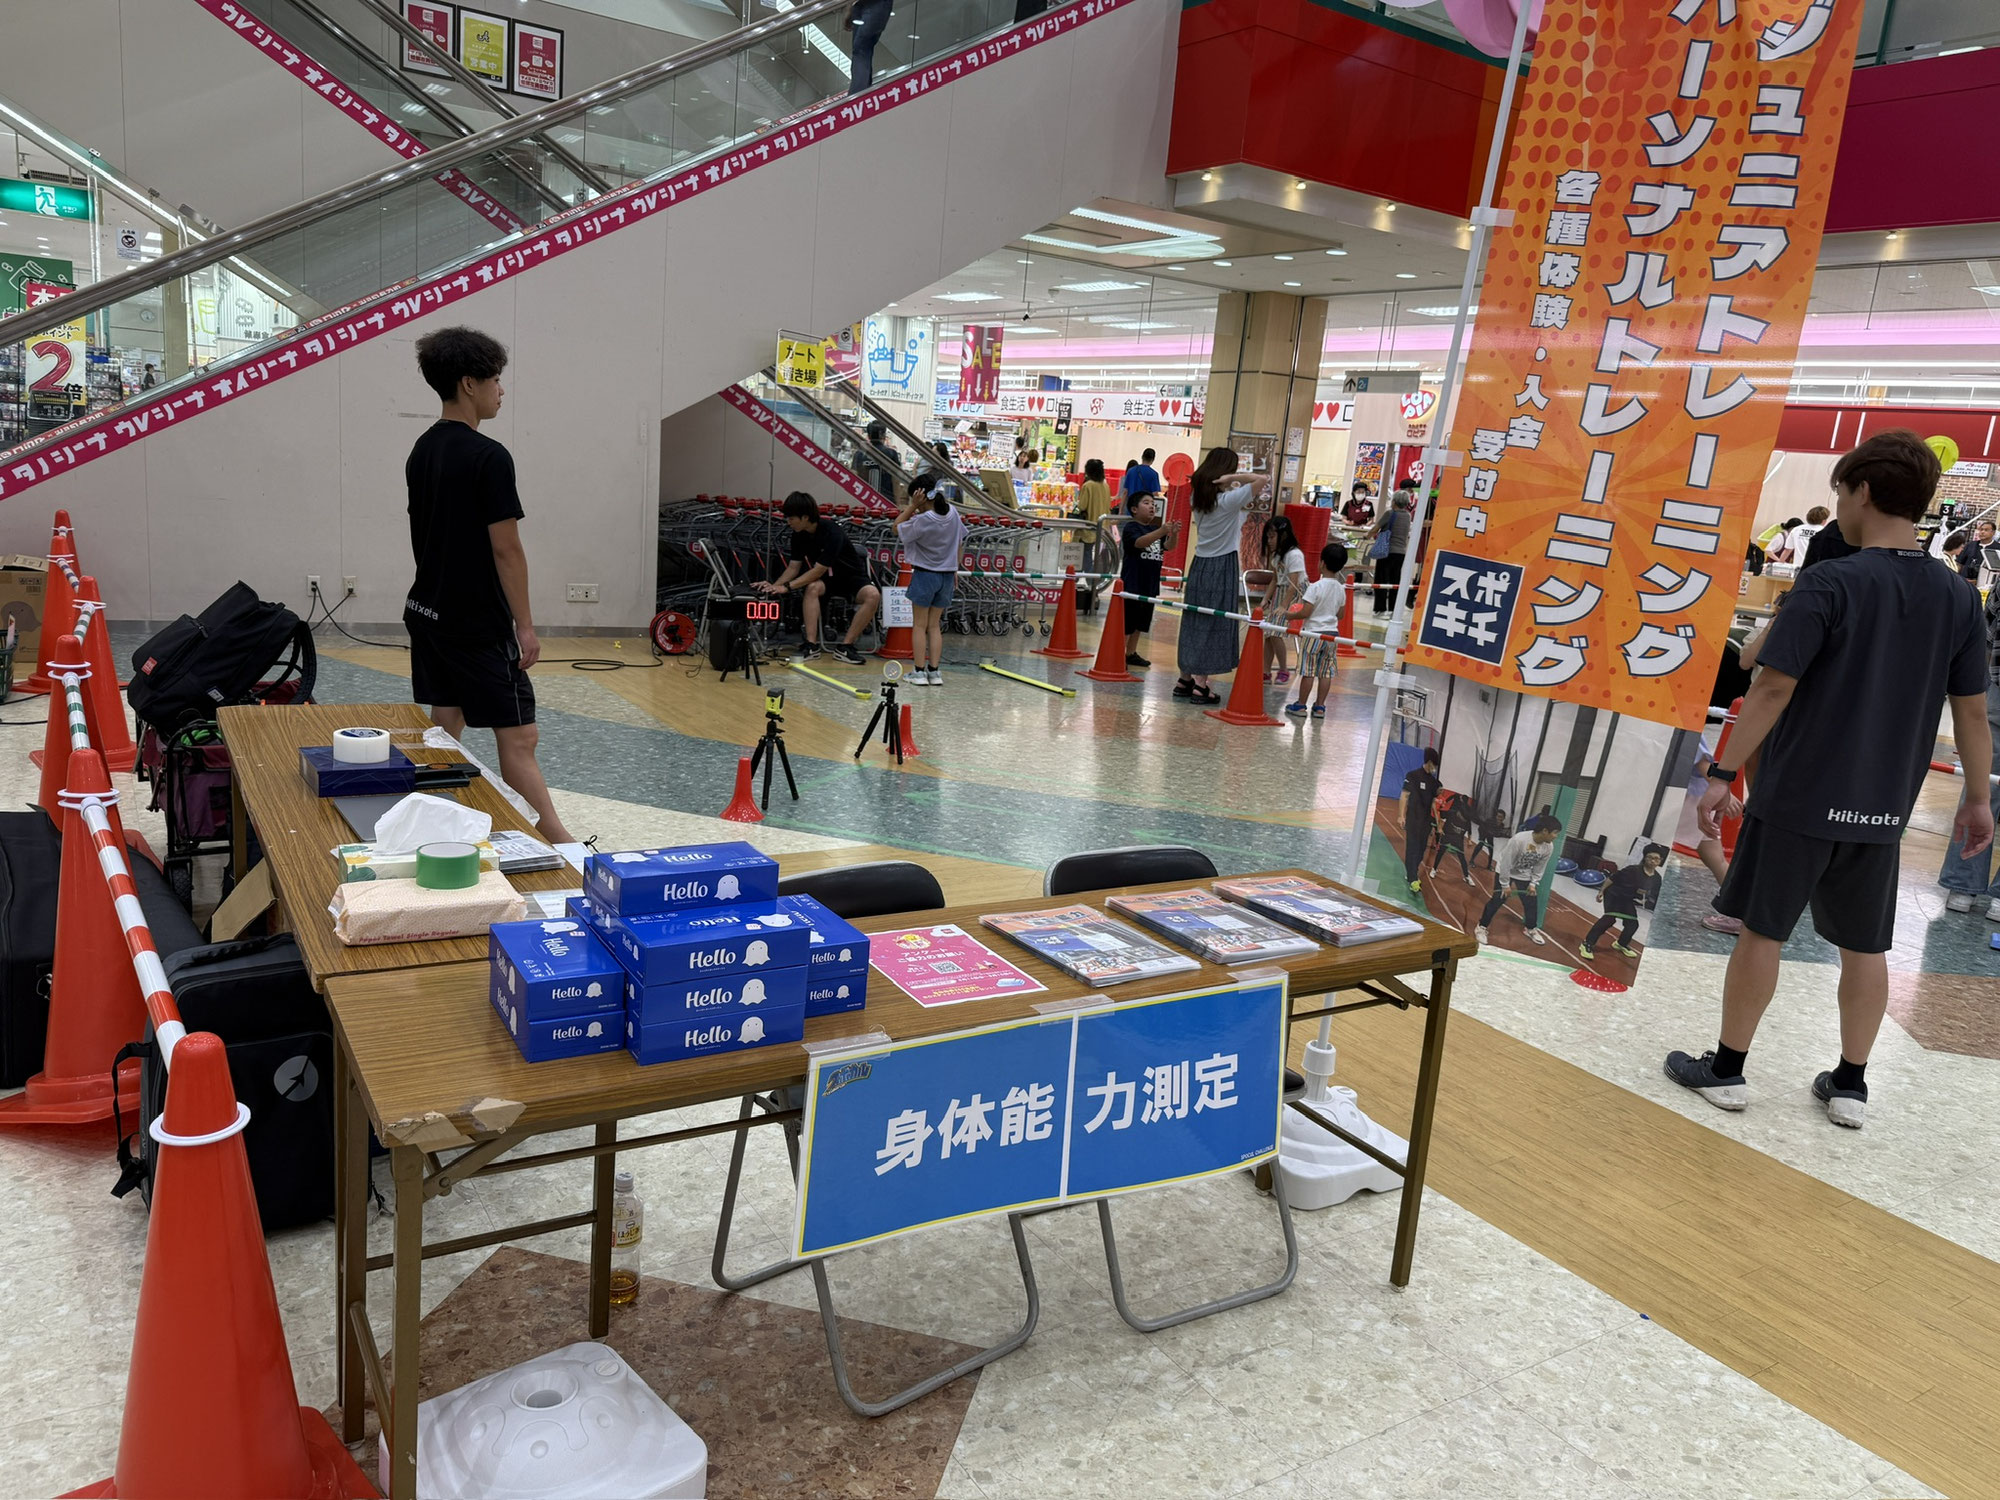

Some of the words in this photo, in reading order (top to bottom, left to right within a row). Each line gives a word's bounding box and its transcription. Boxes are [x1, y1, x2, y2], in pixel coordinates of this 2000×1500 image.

[304, 65, 380, 125] オイシーナ
[12, 431, 108, 482] タノシーナ
[211, 349, 298, 399] オイシーナ
[303, 312, 386, 357] タノシーナ
[475, 239, 550, 284] オイシーナ
[554, 206, 626, 247] タノシーナ
[704, 144, 769, 184] オイシーナ
[773, 114, 837, 151] タノシーナ
[904, 60, 963, 99] オイシーナ
[966, 34, 1022, 67] タノシーナ
[786, 346, 816, 363] カート
[961, 327, 1001, 369] SALE
[782, 369, 817, 385] 置き場
[1001, 395, 1026, 411] 食生活
[1123, 398, 1155, 417] 食生活
[803, 444, 851, 484] オイシーナ
[1455, 428, 1508, 538] 受付中
[1942, 505, 1950, 514] 3
[663, 851, 713, 863] Hello
[664, 881, 709, 901] Hello
[359, 936, 381, 944] Paper
[406, 931, 430, 941] Single
[431, 929, 460, 938] Regular
[542, 937, 570, 957] Hello
[901, 948, 948, 958] アンケート
[689, 949, 736, 969] Hello
[811, 952, 836, 964] Hello
[552, 986, 582, 1000] Hello
[685, 987, 733, 1009] Hello
[809, 989, 834, 1001] Hello
[552, 1026, 583, 1040] Hello
[684, 1025, 732, 1047] Hello
